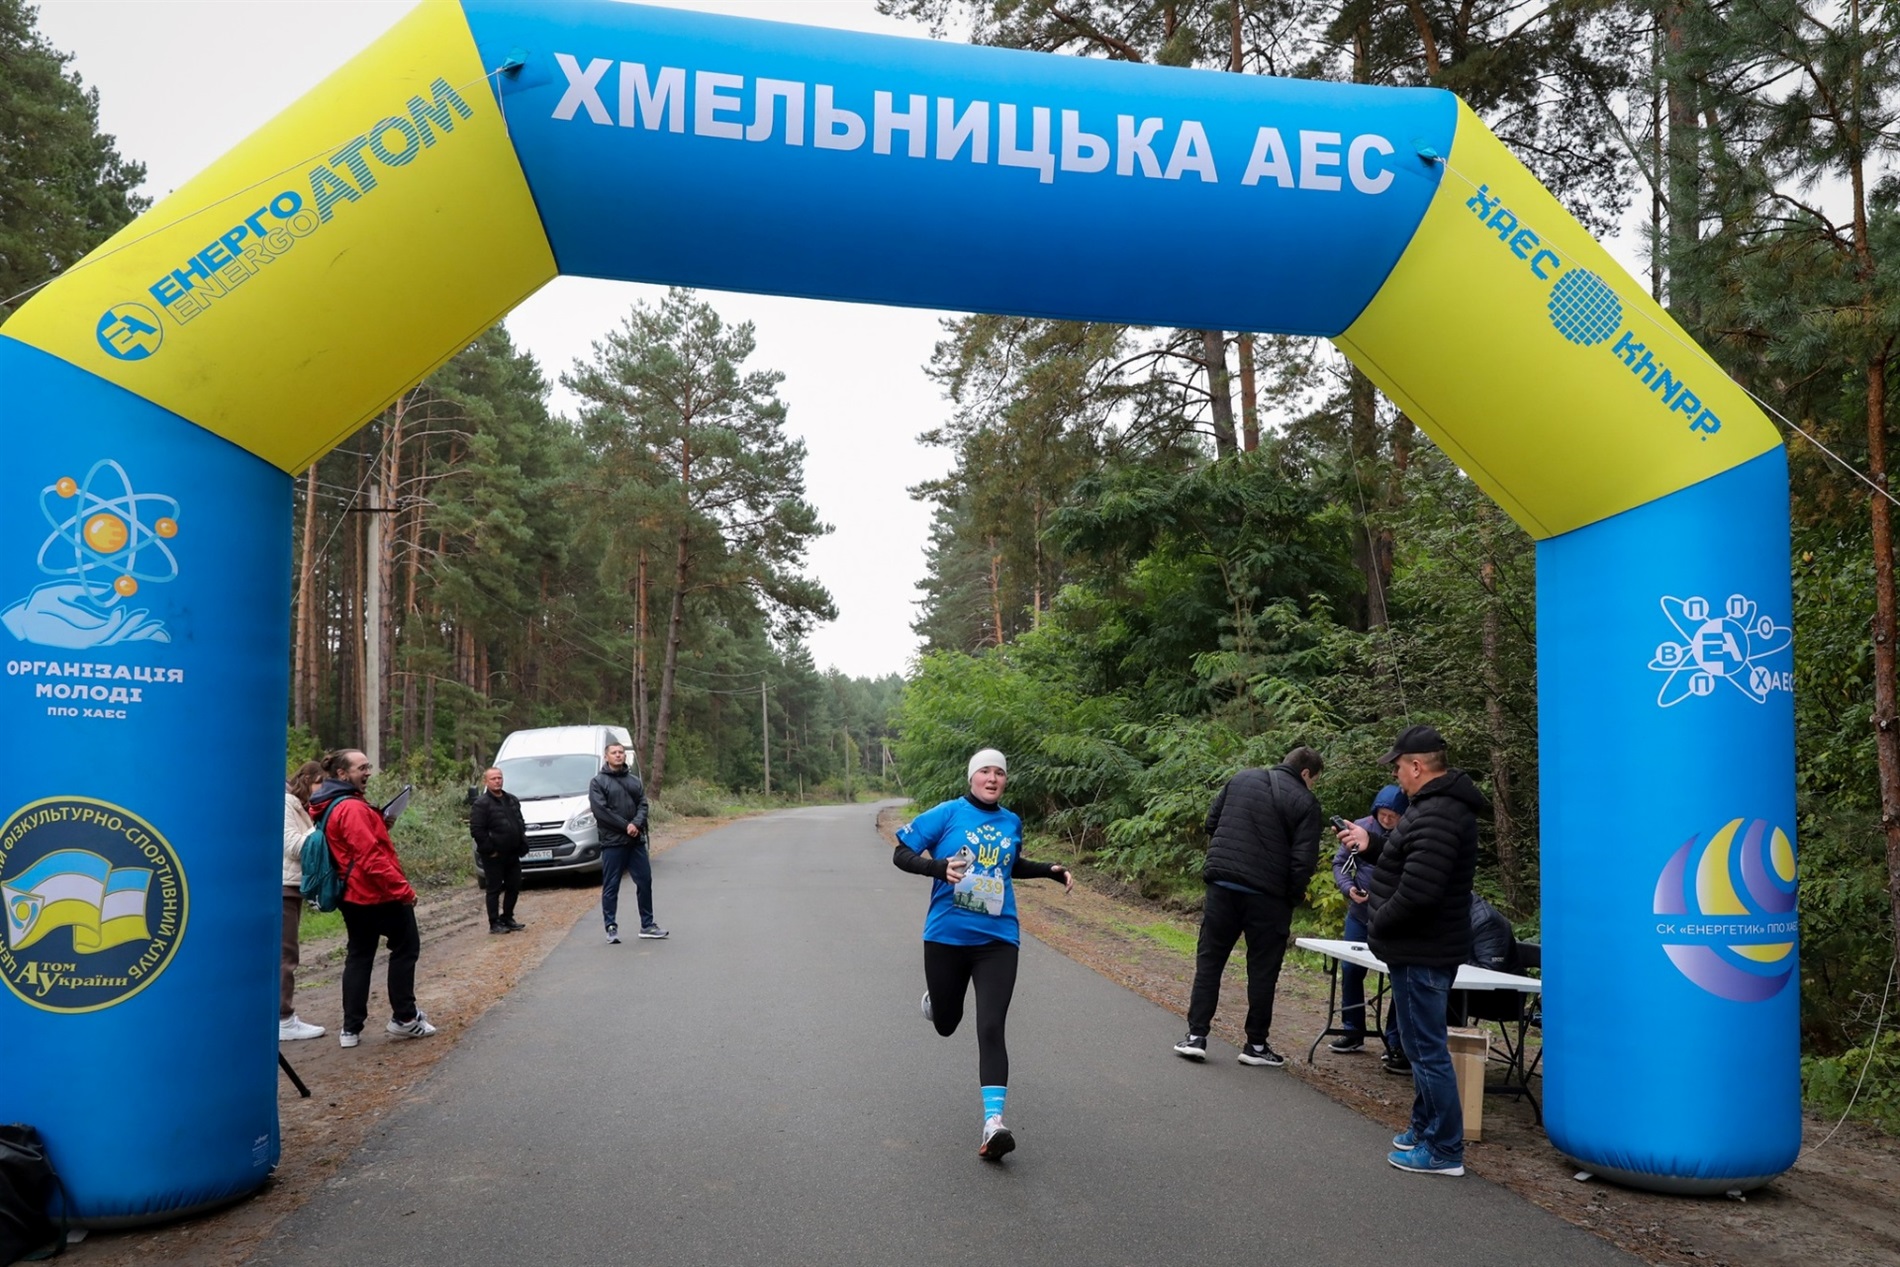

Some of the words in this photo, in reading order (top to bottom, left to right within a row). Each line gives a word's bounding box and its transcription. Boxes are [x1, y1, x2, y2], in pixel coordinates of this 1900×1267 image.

[550, 52, 1219, 185] ХМЕЛЬНИЦЬКА
[1240, 126, 1396, 196] АЕС
[6, 660, 184, 684] ОРГАНІЗАЦІЯ
[35, 683, 143, 704] МОЛОДІ
[47, 706, 79, 717] ППО
[83, 708, 127, 719] ХАЕС
[3, 806, 178, 937] ФІЗКУЛЬТУРНО-СПОРТИВНИЙ
[127, 938, 168, 980] КЛУБ
[973, 877, 1003, 895] 239
[1656, 923, 1676, 934] СК
[1680, 924, 1765, 935] «ЕНЕРГЕТИК»
[1767, 922, 1785, 934] ППО
[36, 972, 128, 997] України
